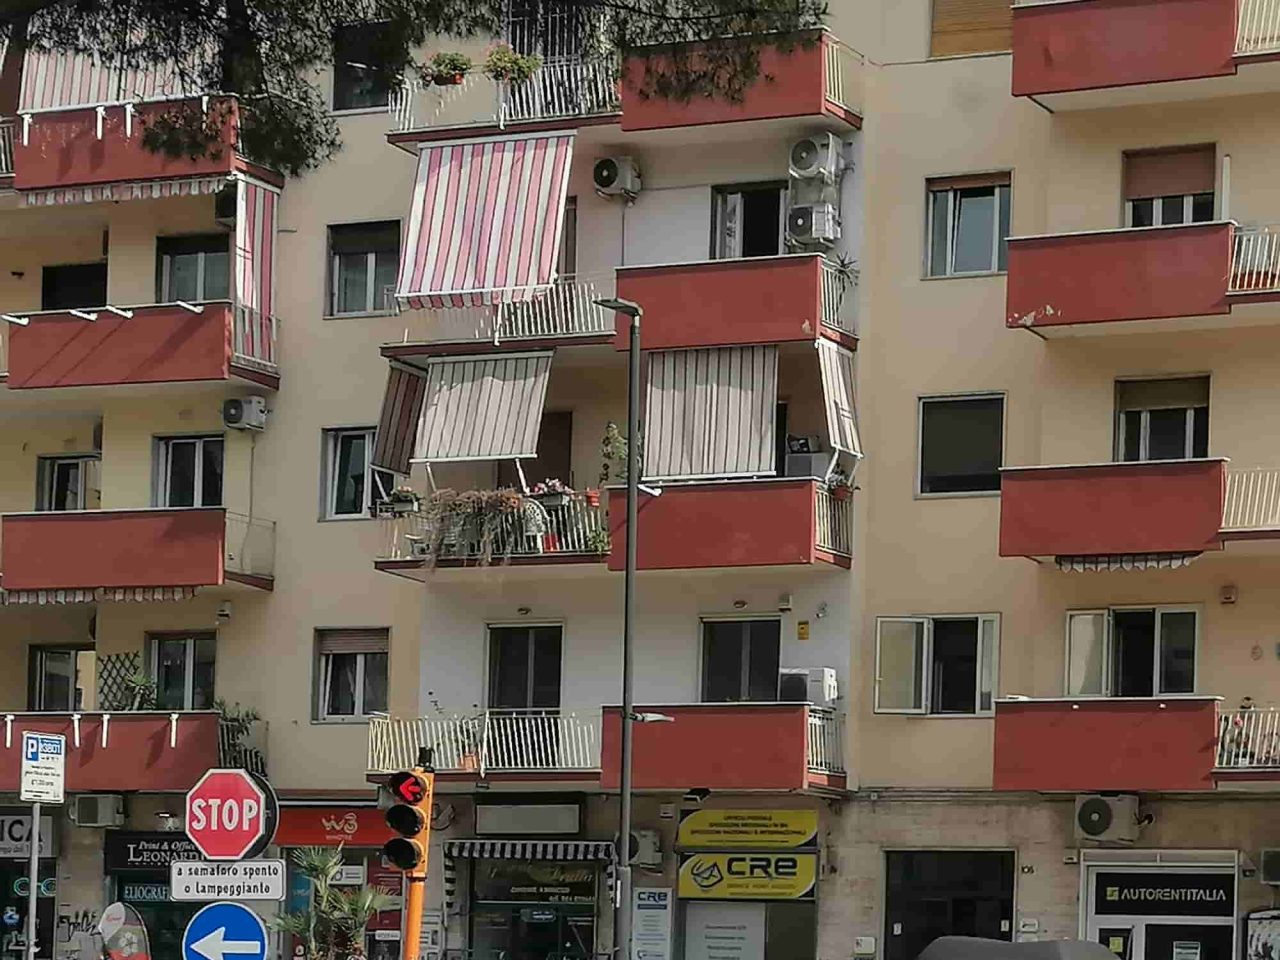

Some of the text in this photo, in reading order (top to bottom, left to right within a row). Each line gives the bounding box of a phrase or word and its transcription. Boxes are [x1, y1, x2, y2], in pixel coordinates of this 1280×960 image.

[191, 798, 258, 830] STOP
[177, 864, 279, 879] a semaforo spento
[184, 882, 270, 896] o lampeggiante
[1121, 888, 1226, 901] AUTORENTITALIA
